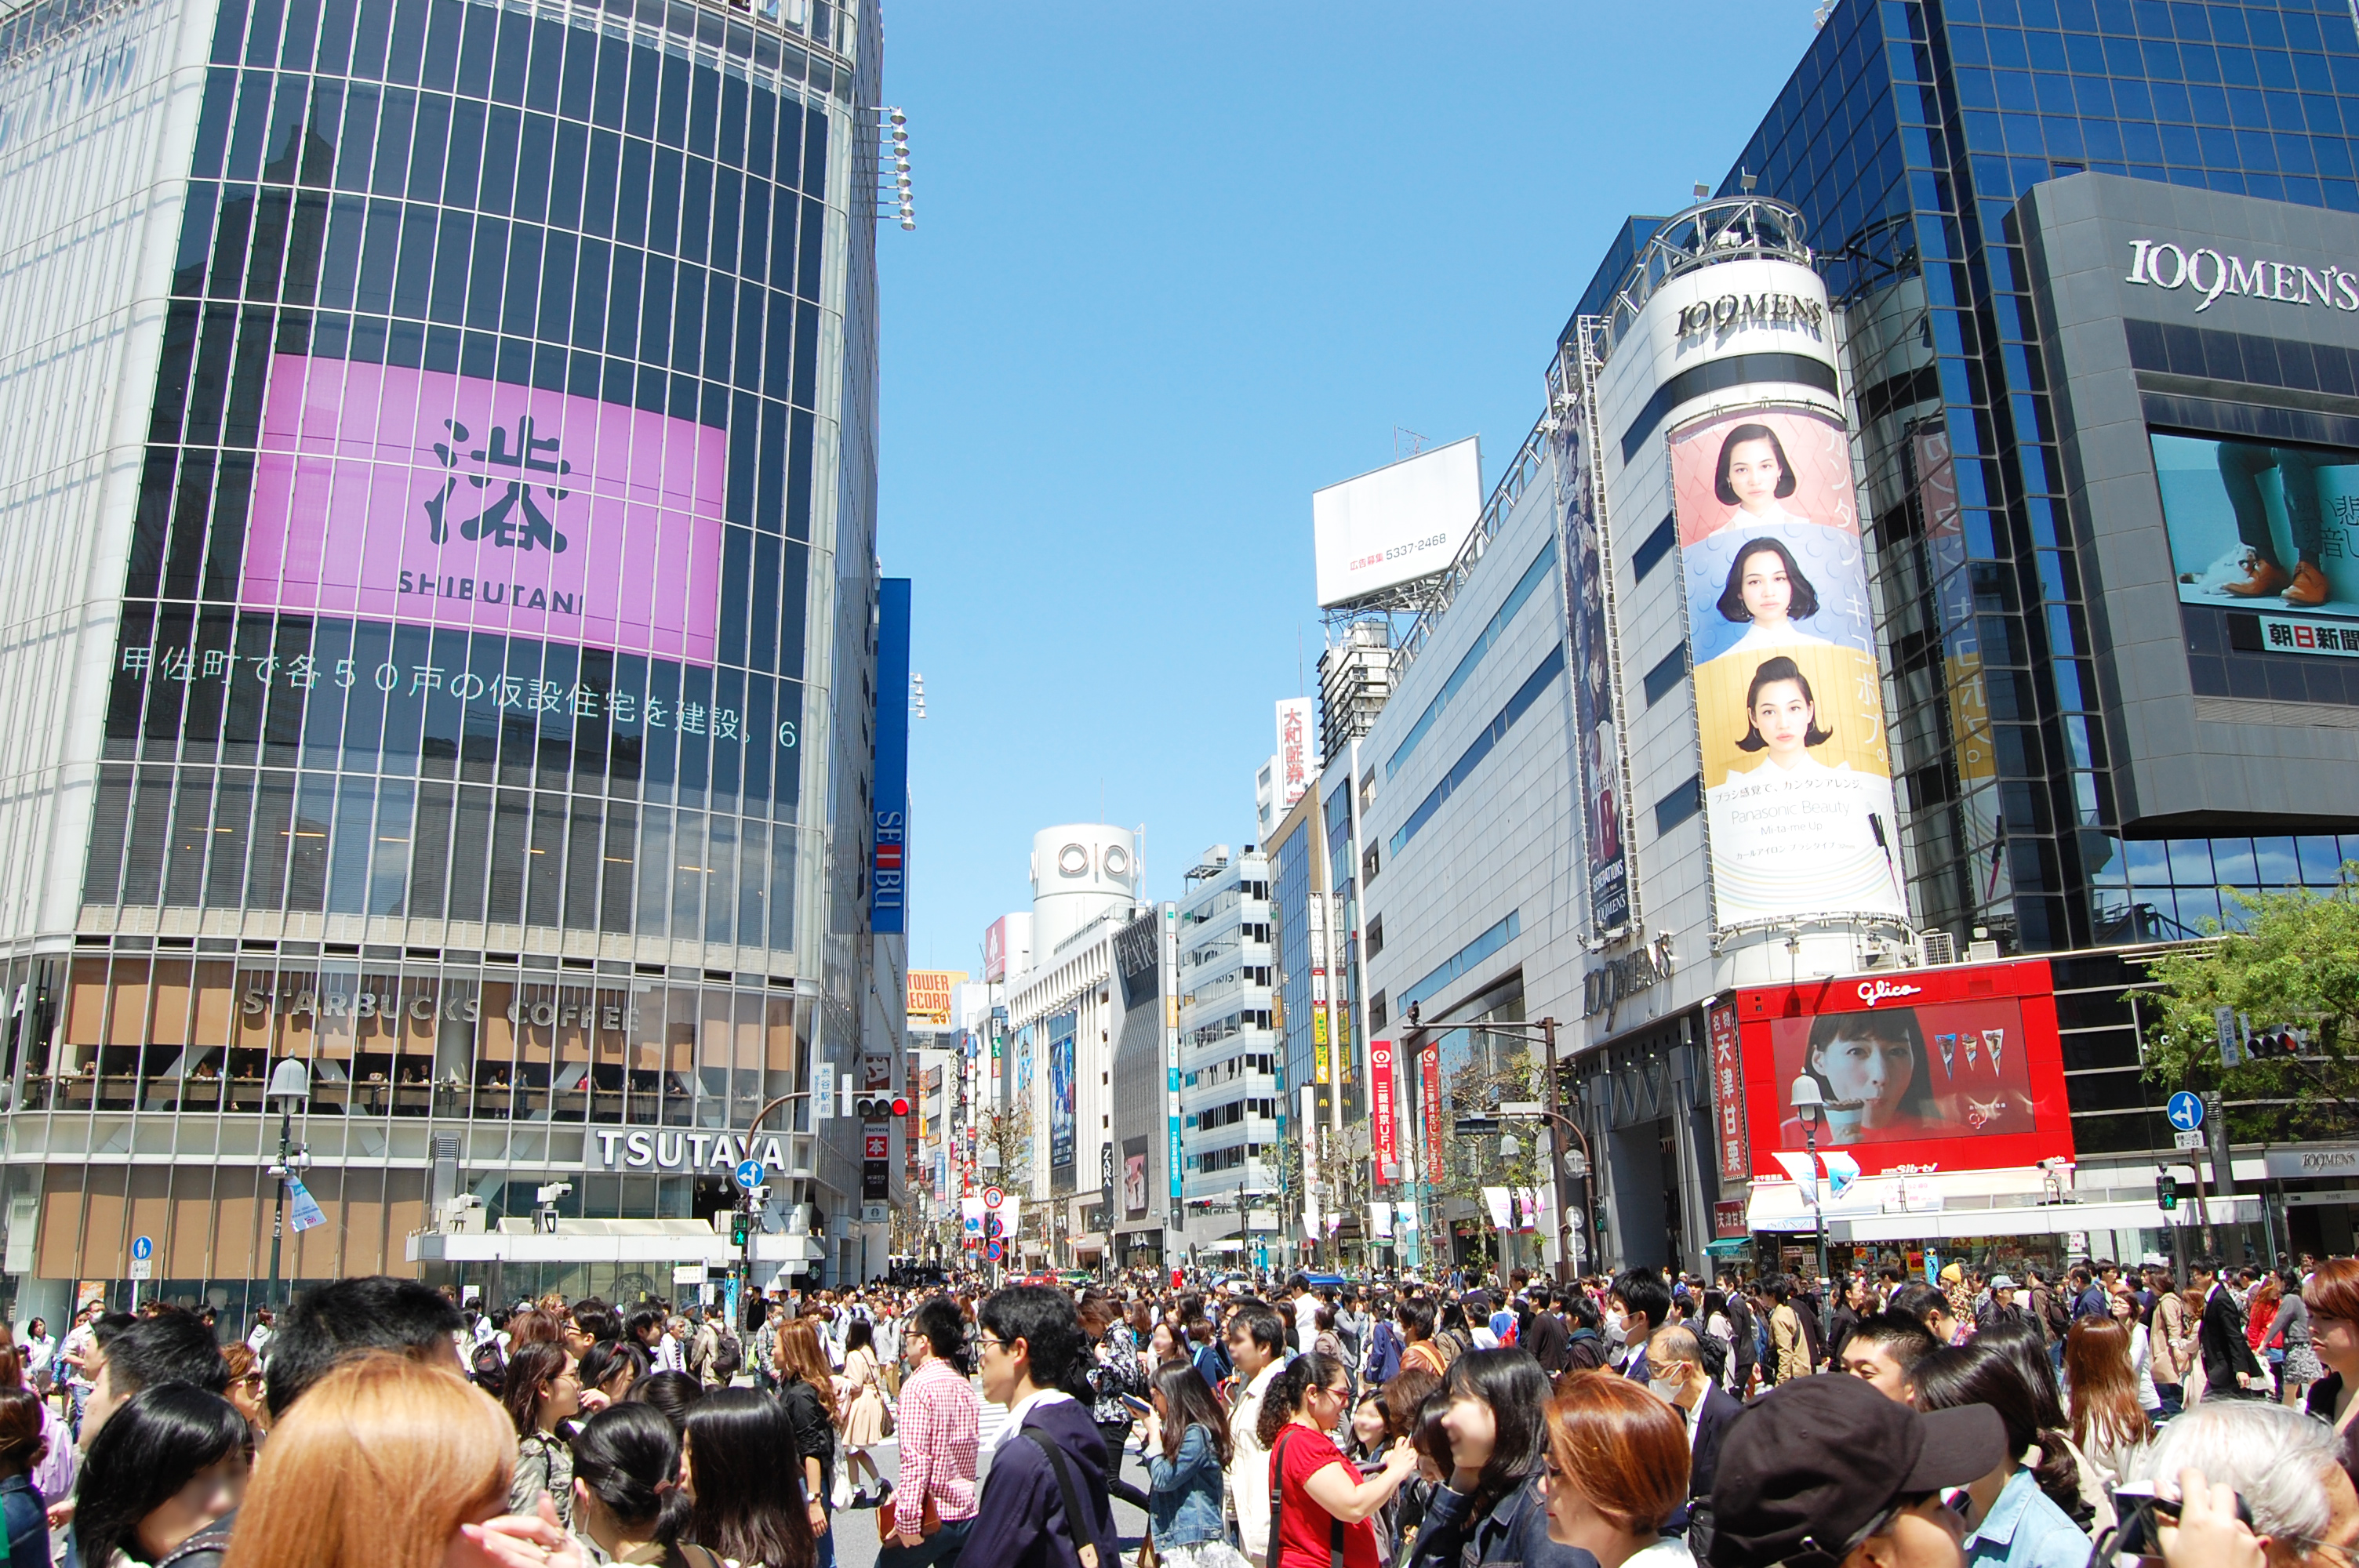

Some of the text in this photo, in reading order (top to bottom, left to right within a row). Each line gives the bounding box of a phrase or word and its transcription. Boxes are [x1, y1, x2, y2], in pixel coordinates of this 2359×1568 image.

[2124, 238, 2359, 314] 109MEN'S
[1675, 292, 1823, 336] 109MEN'S
[1350, 533, 1447, 572] 広告募集 5337-2468
[2268, 623, 2359, 652] 朝日新聞
[1284, 707, 1304, 786] 大和証券
[1731, 800, 1851, 825] Panasonic Beauty
[1808, 821, 1823, 832] Up
[874, 811, 903, 909] SEIBU
[907, 974, 950, 992] TOWER
[907, 992, 951, 1011] ECORD
[1858, 979, 1921, 1007] Glico
[243, 988, 640, 1032] STARBUCKS COFFEE
[820, 1068, 831, 1113] 渋谷駅前
[950, 1048, 958, 1108] KARAOKE
[1716, 1032, 1742, 1173] 天津甘栗
[597, 1129, 786, 1171] TSUTAYA
[868, 1138, 885, 1156] 本
[1103, 1149, 1112, 1187] ZARA
[1717, 1209, 1747, 1229] 天津甘栗
